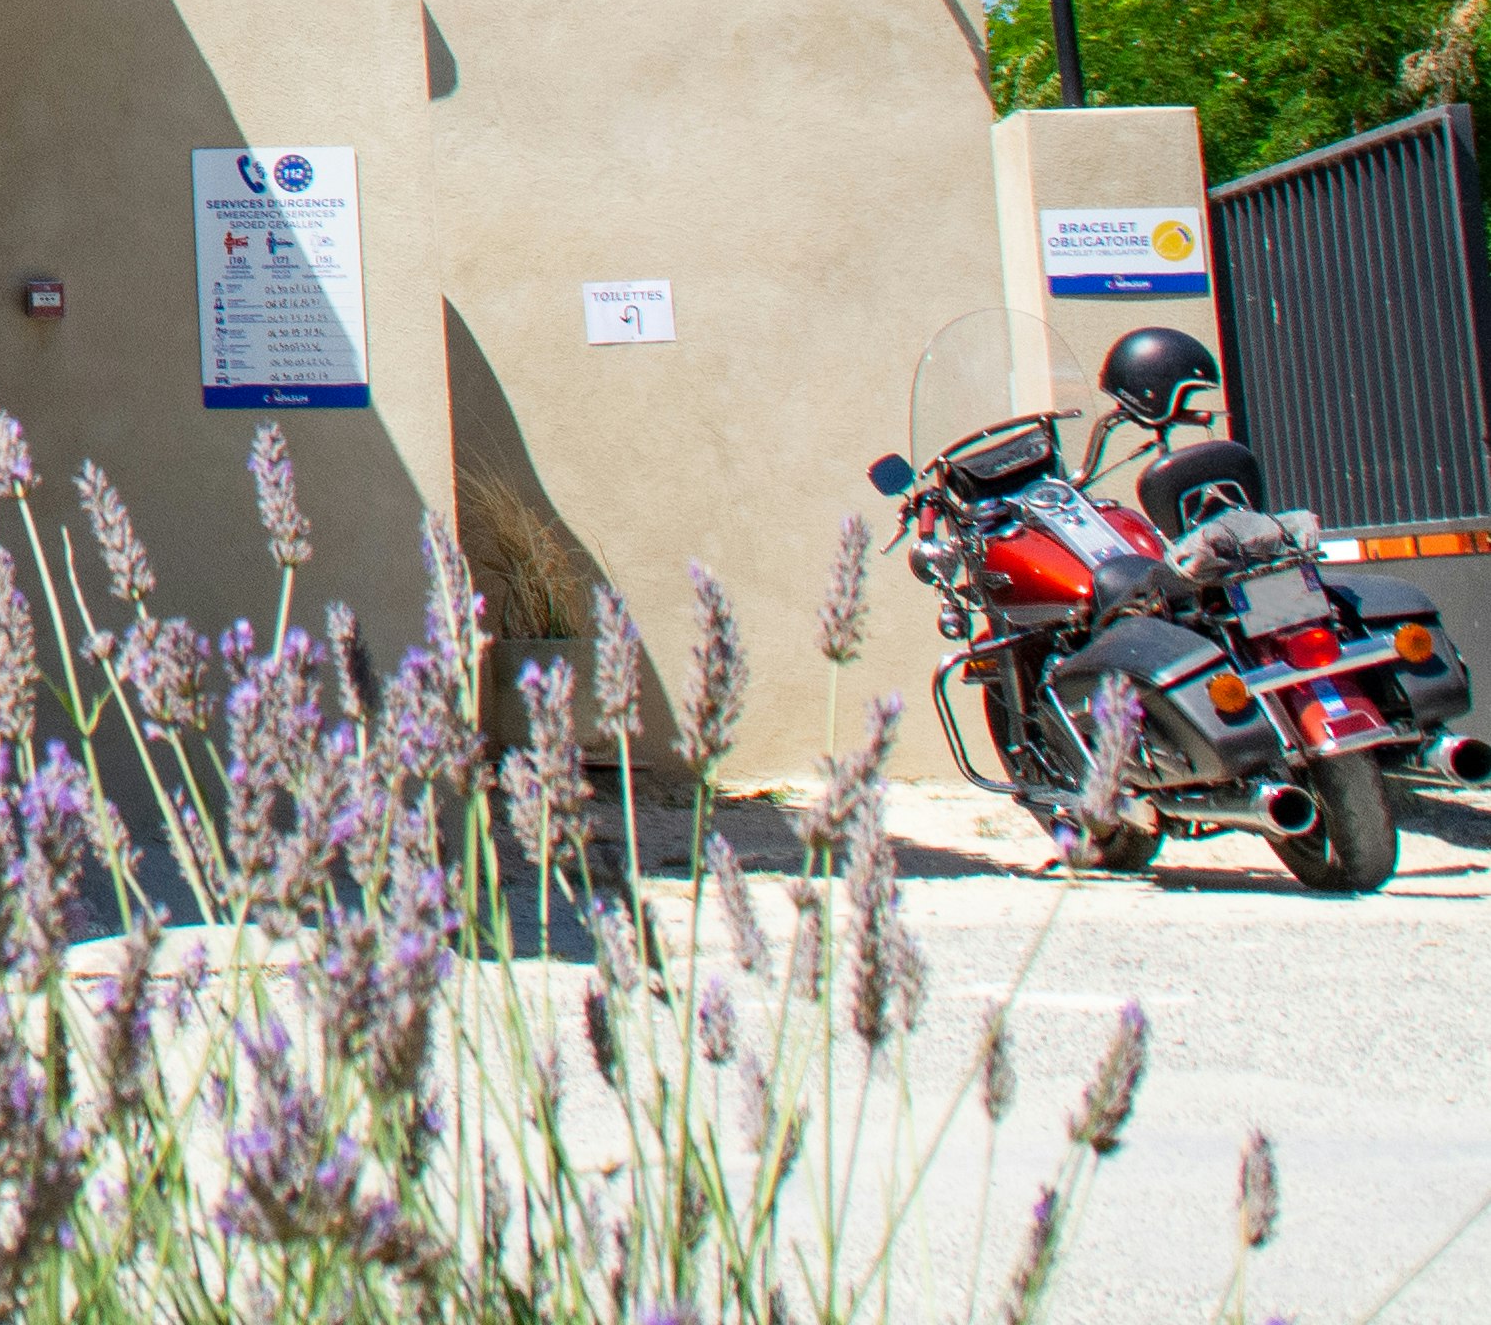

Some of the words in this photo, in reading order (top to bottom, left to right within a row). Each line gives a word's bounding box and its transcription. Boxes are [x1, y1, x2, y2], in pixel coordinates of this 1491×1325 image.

[283, 168, 304, 179] 112
[206, 199, 264, 210] SERVICES
[267, 198, 345, 209] D'URGENCES
[216, 210, 281, 220] EMERGENCY
[285, 209, 336, 219] SERVICES
[229, 220, 266, 230] SPOED
[267, 219, 323, 230] GEVALLEN
[1058, 222, 1137, 234] BRACELET
[1048, 235, 1151, 248] OBLIGATOIRE
[592, 291, 663, 302] TOILETTES
